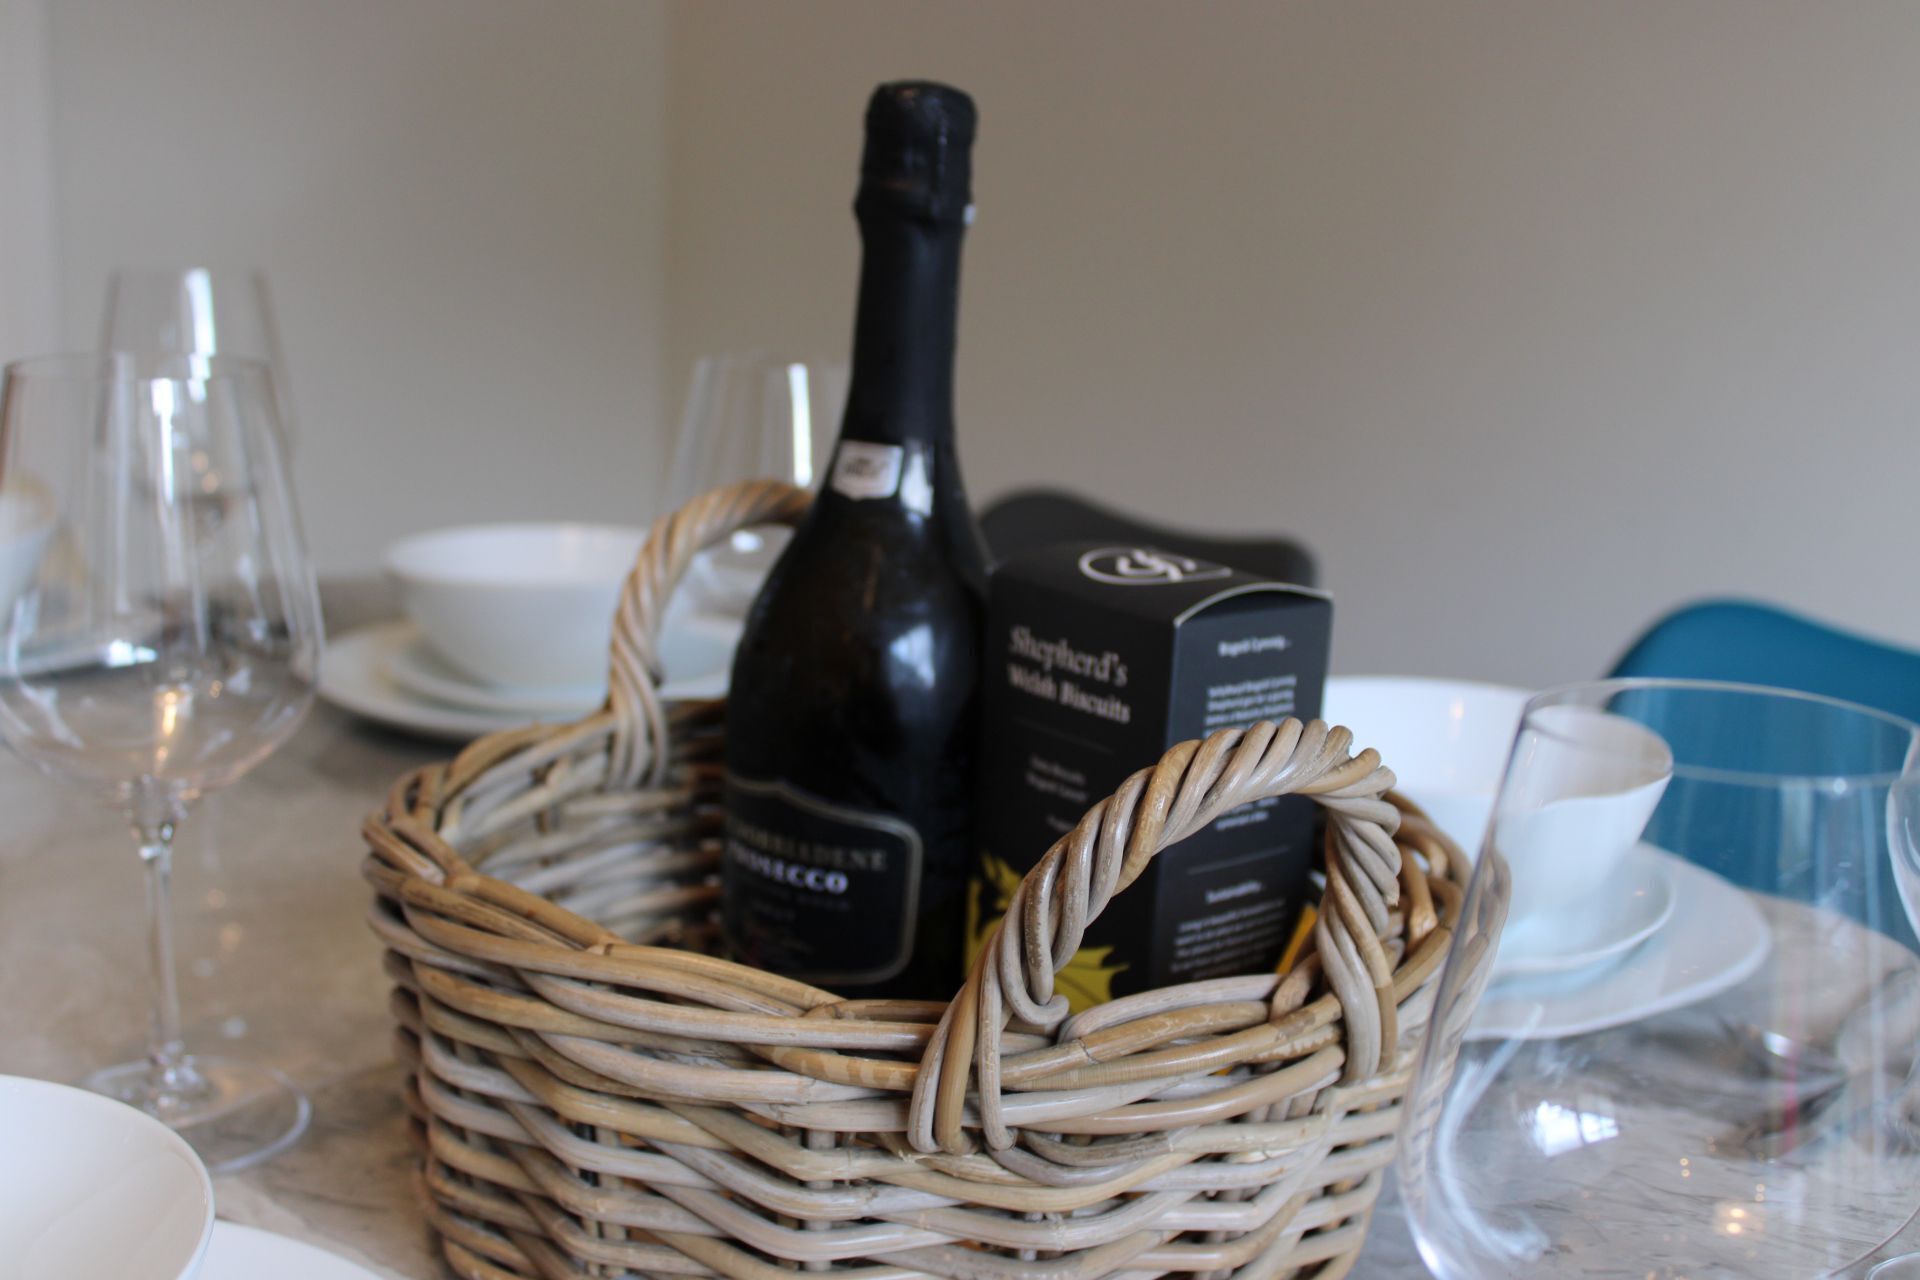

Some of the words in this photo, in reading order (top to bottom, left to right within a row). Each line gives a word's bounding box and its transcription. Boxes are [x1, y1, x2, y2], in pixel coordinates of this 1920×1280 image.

[1010, 625, 1128, 687] Shepherd's
[1007, 662, 1058, 701] Welsh
[1060, 681, 1131, 725] Biscuits
